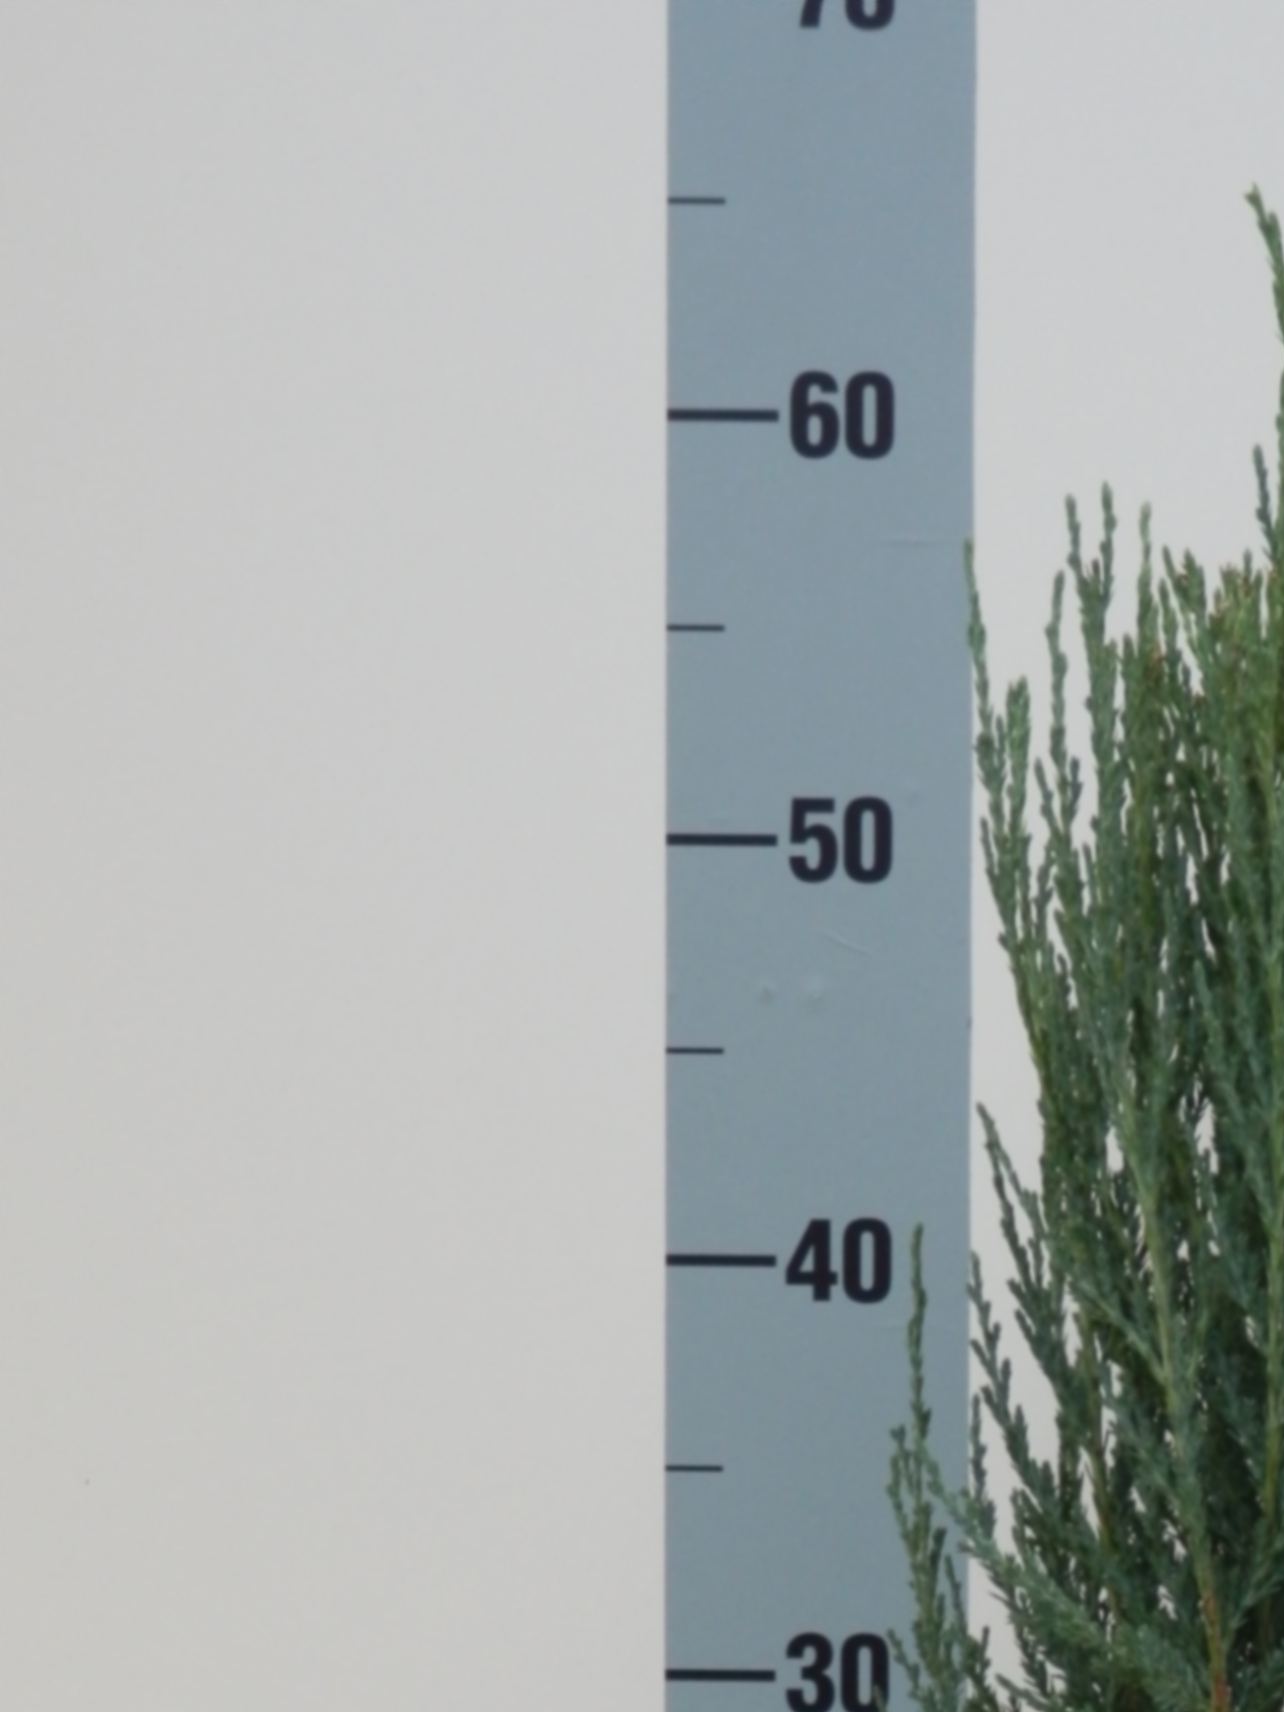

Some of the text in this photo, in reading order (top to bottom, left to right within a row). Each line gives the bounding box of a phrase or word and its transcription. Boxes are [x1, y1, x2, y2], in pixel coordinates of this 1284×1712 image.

[789, 370, 895, 460] 60
[788, 796, 893, 886] 50
[784, 1216, 892, 1304] 40
